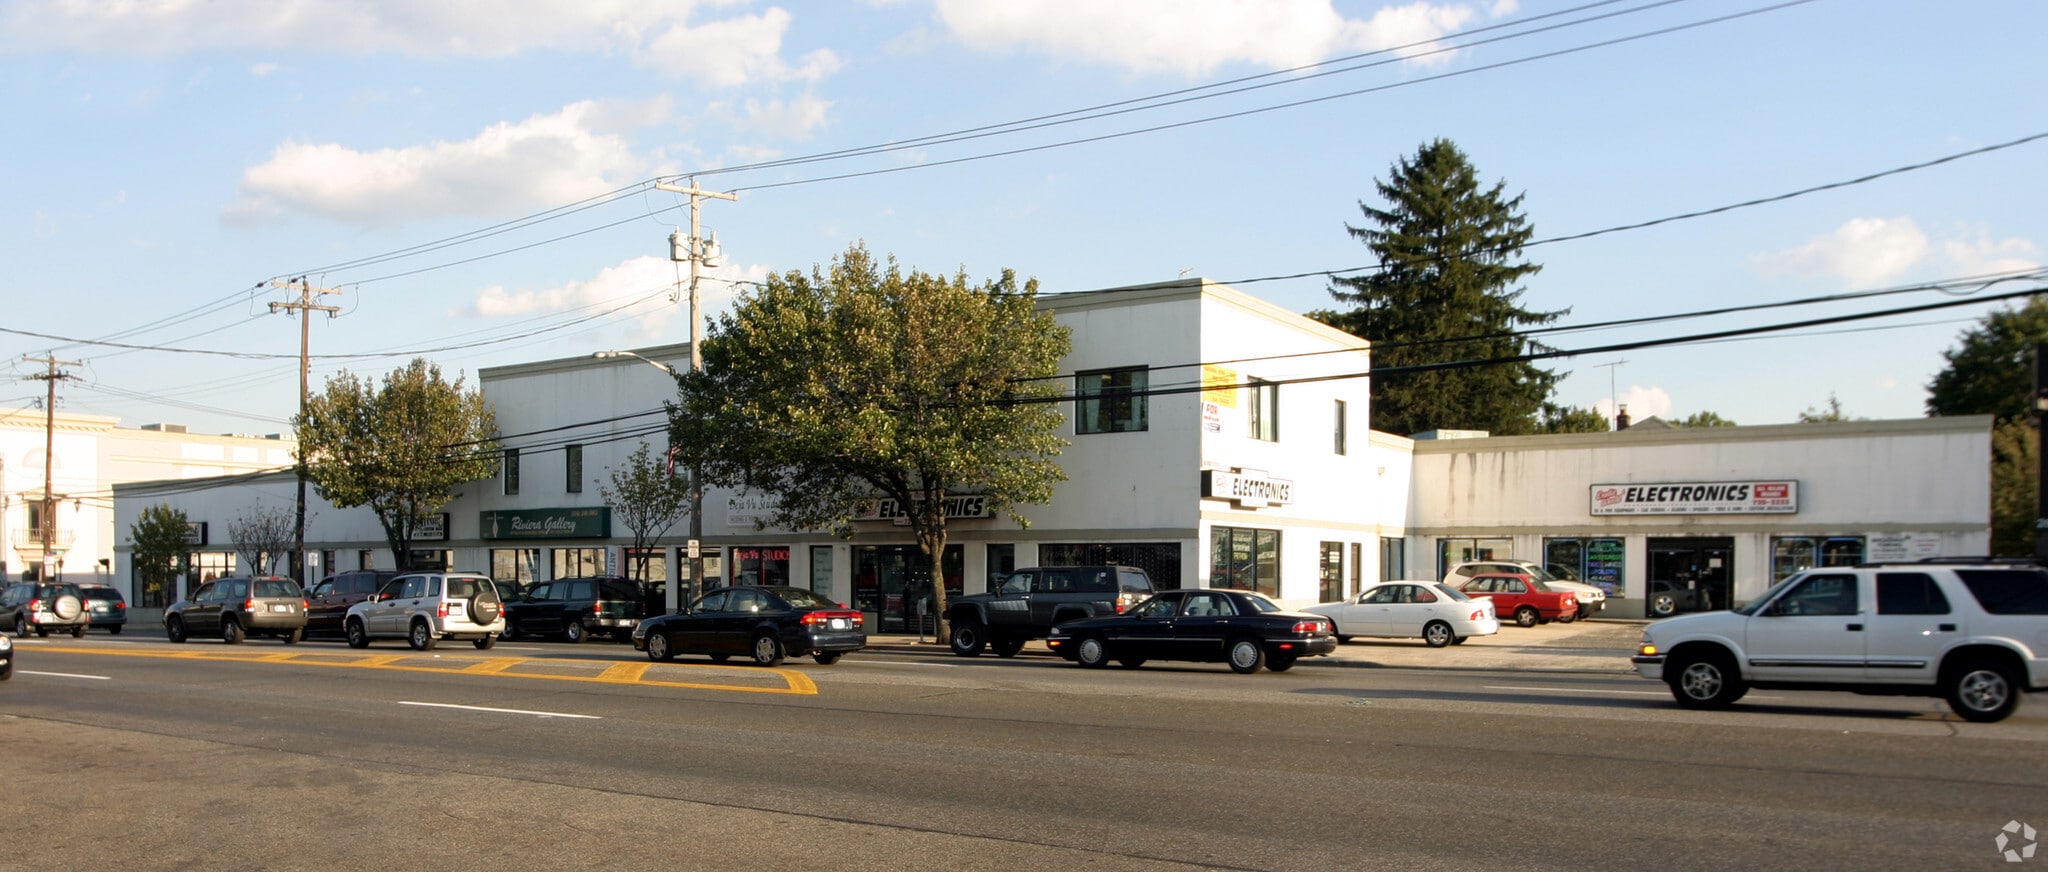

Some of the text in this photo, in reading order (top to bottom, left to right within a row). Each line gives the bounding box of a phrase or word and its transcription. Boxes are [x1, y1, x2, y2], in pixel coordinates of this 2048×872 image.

[1233, 478, 1289, 501] ELECTRONICS
[1625, 484, 1750, 503] ELECTRONICS
[879, 497, 984, 518] ELNICS
[511, 516, 576, 535] Riviera Gallery
